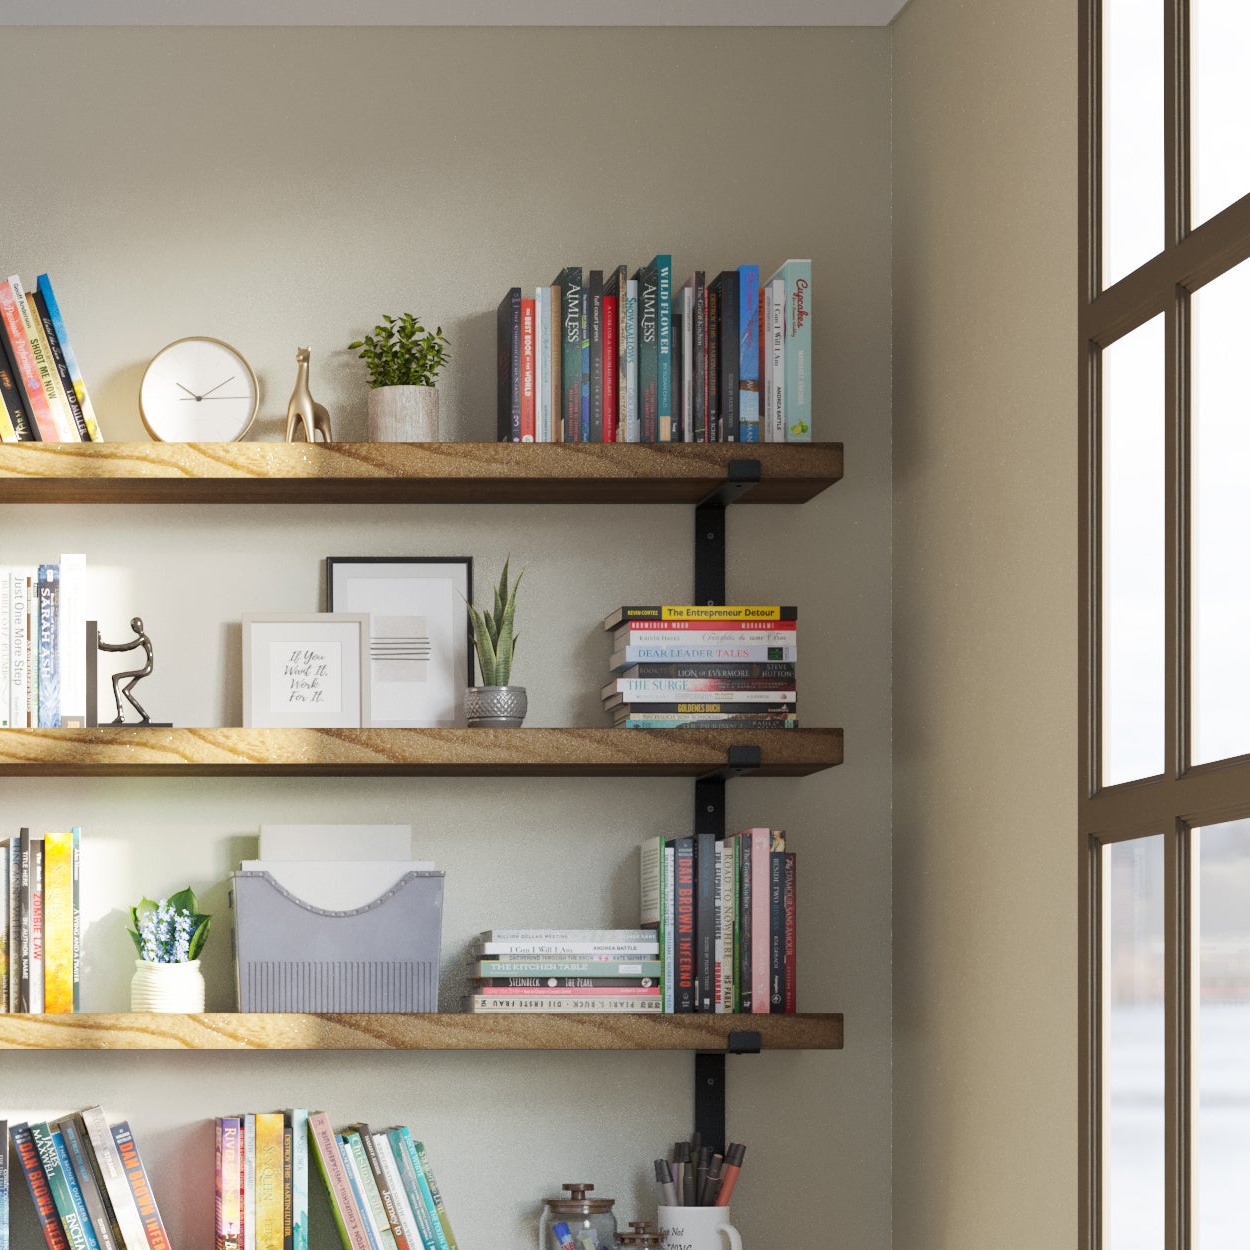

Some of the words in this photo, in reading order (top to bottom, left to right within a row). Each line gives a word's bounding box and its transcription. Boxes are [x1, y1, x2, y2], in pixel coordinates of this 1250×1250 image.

[660, 267, 669, 300] WILD
[566, 283, 580, 343] AIMLESS
[642, 283, 656, 342] AIMLESS
[793, 279, 808, 328] Cupcakes
[660, 303, 669, 354] FLOWER
[30, 338, 45, 364] SHOOT
[40, 367, 50, 378] ME
[43, 381, 57, 400] NOW
[14, 576, 24, 599] Just
[14, 602, 24, 626] One
[40, 587, 50, 642] SARAH
[686, 609, 742, 618] Entrepreneur
[14, 628, 24, 657] More
[12, 659, 24, 686] Step
[40, 650, 50, 679] ASH
[679, 859, 692, 884] DAN
[724, 855, 732, 883] ROAD
[679, 888, 692, 933] BROWN
[724, 889, 732, 903] TO
[33, 893, 42, 933] ZOMBIE
[33, 938, 42, 960] LAW
[724, 911, 732, 958] NOWHERE
[679, 938, 692, 987] INFERNO
[33, 1129, 54, 1179] MAXWELL
[120, 1141, 140, 1169] DAN
[19, 1142, 37, 1169] DAN
[28, 1170, 52, 1216] BROWN
[129, 1170, 154, 1216] BROWN
[382, 1189, 398, 1224] Journey
[394, 1225, 402, 1235] to
